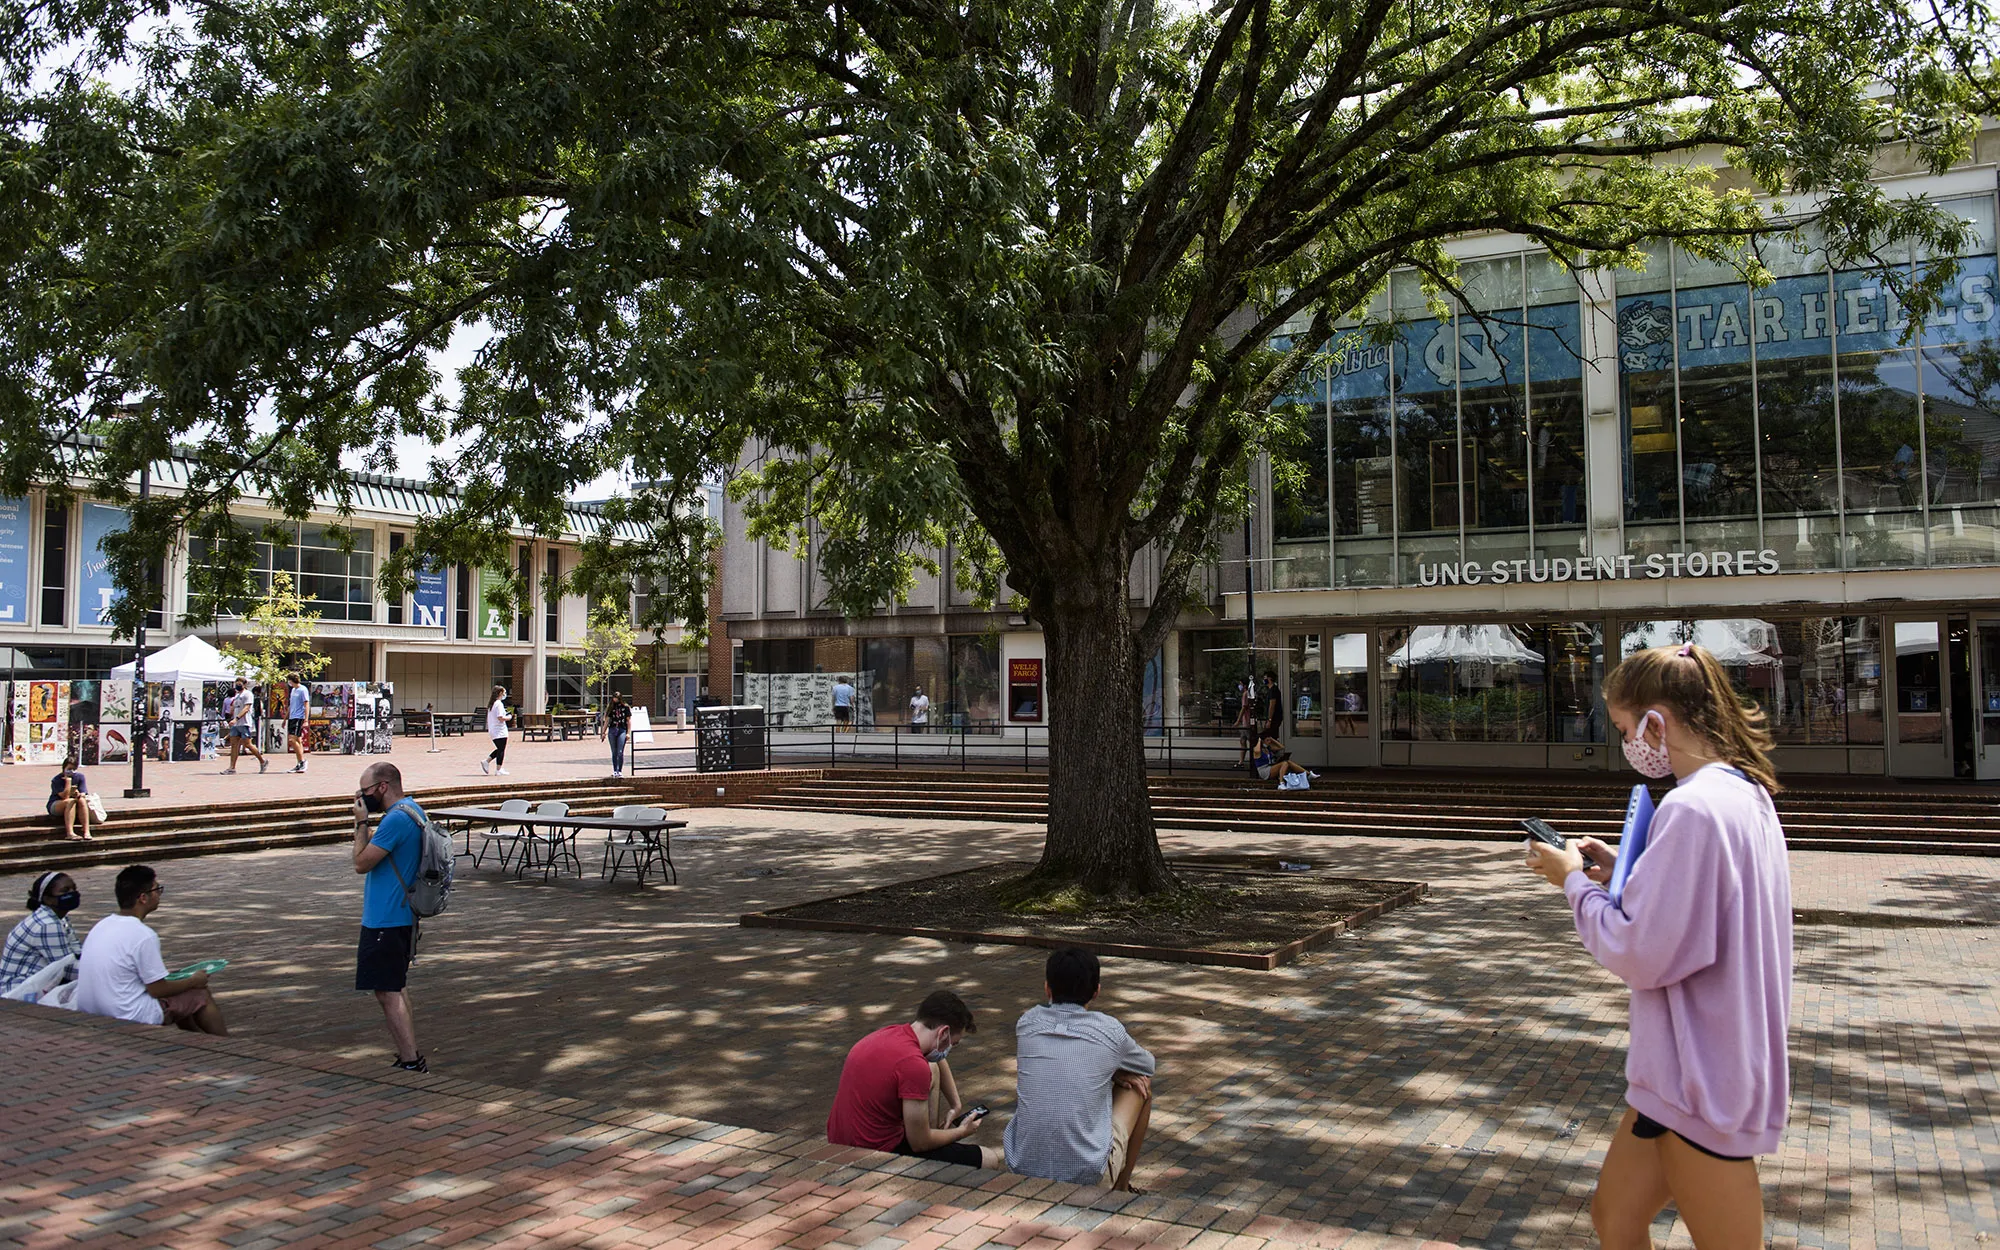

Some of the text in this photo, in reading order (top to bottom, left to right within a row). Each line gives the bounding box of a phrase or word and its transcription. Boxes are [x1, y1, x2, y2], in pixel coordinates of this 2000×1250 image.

[1631, 305, 1650, 319] UNC
[1678, 297, 1789, 350] TAR
[1419, 549, 1780, 587] UNC STUDENT STORES
[419, 605, 443, 626] N
[484, 609, 506, 635] A
[325, 626, 440, 638] GRAHAM STUDENT UNION
